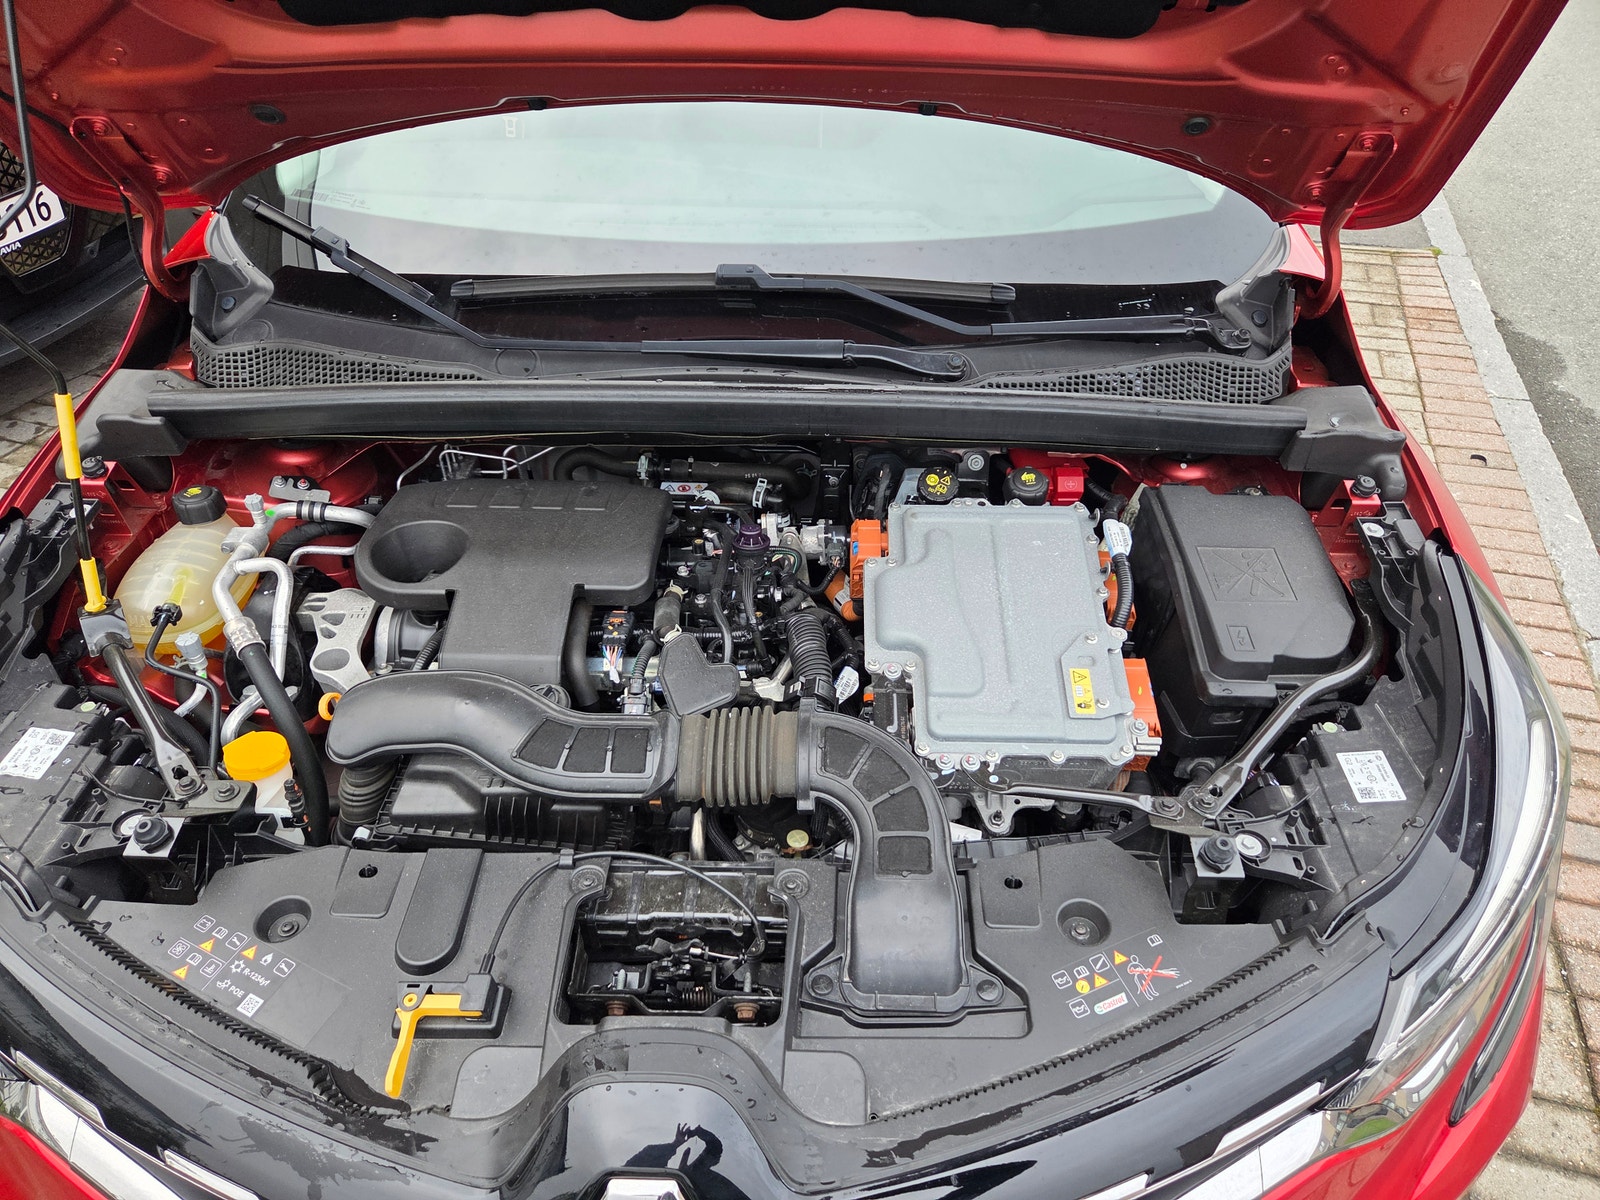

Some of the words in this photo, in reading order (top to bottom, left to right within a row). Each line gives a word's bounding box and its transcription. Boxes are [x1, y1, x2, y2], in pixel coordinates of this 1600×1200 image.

[242, 968, 271, 987] R-1234yf
[228, 985, 245, 998] POE
[1102, 995, 1126, 1011] Castrol
